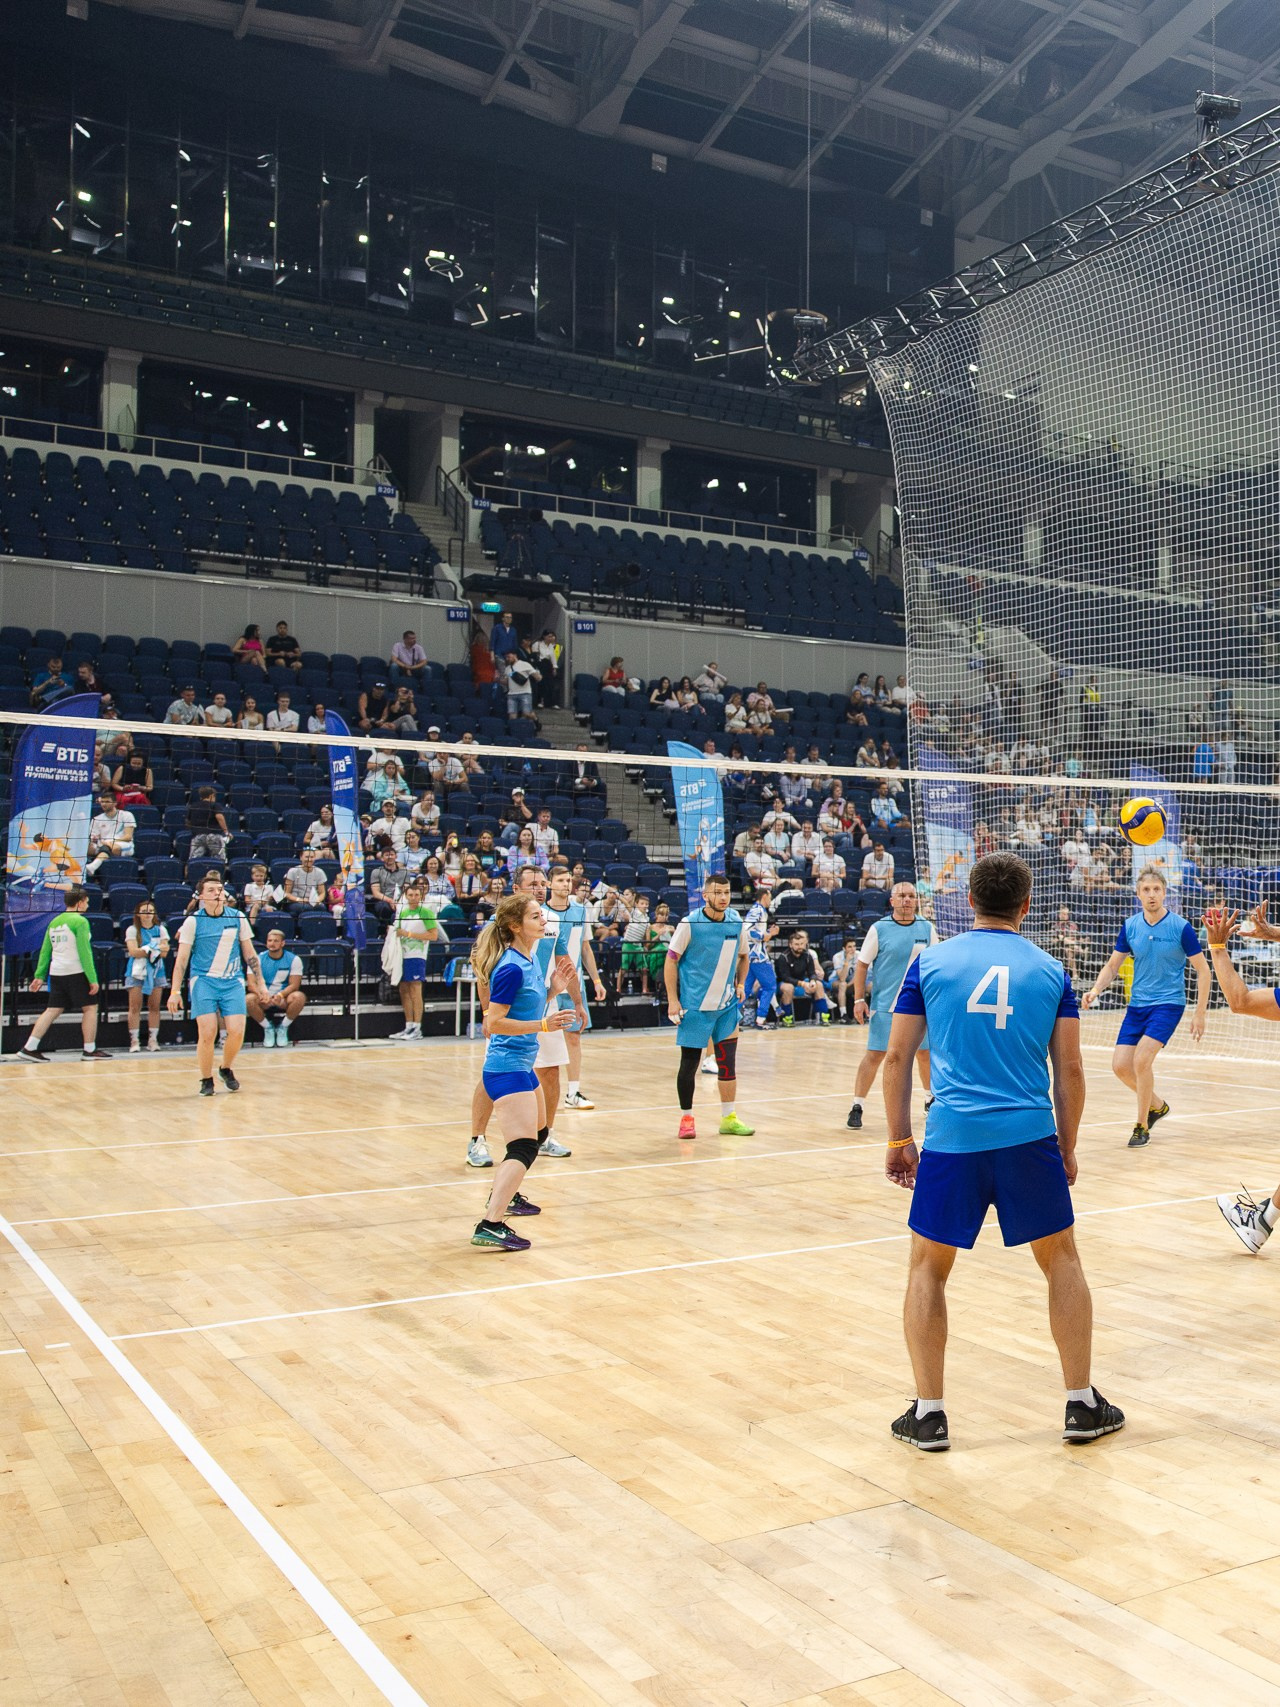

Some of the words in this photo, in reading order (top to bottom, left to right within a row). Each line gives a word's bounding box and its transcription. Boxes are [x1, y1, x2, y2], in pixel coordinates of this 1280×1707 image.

[583, 622, 594, 630] 101
[57, 747, 89, 763] ВТБ
[24, 772, 54, 780] ГРУППЫ
[966, 965, 1014, 1030] 4
